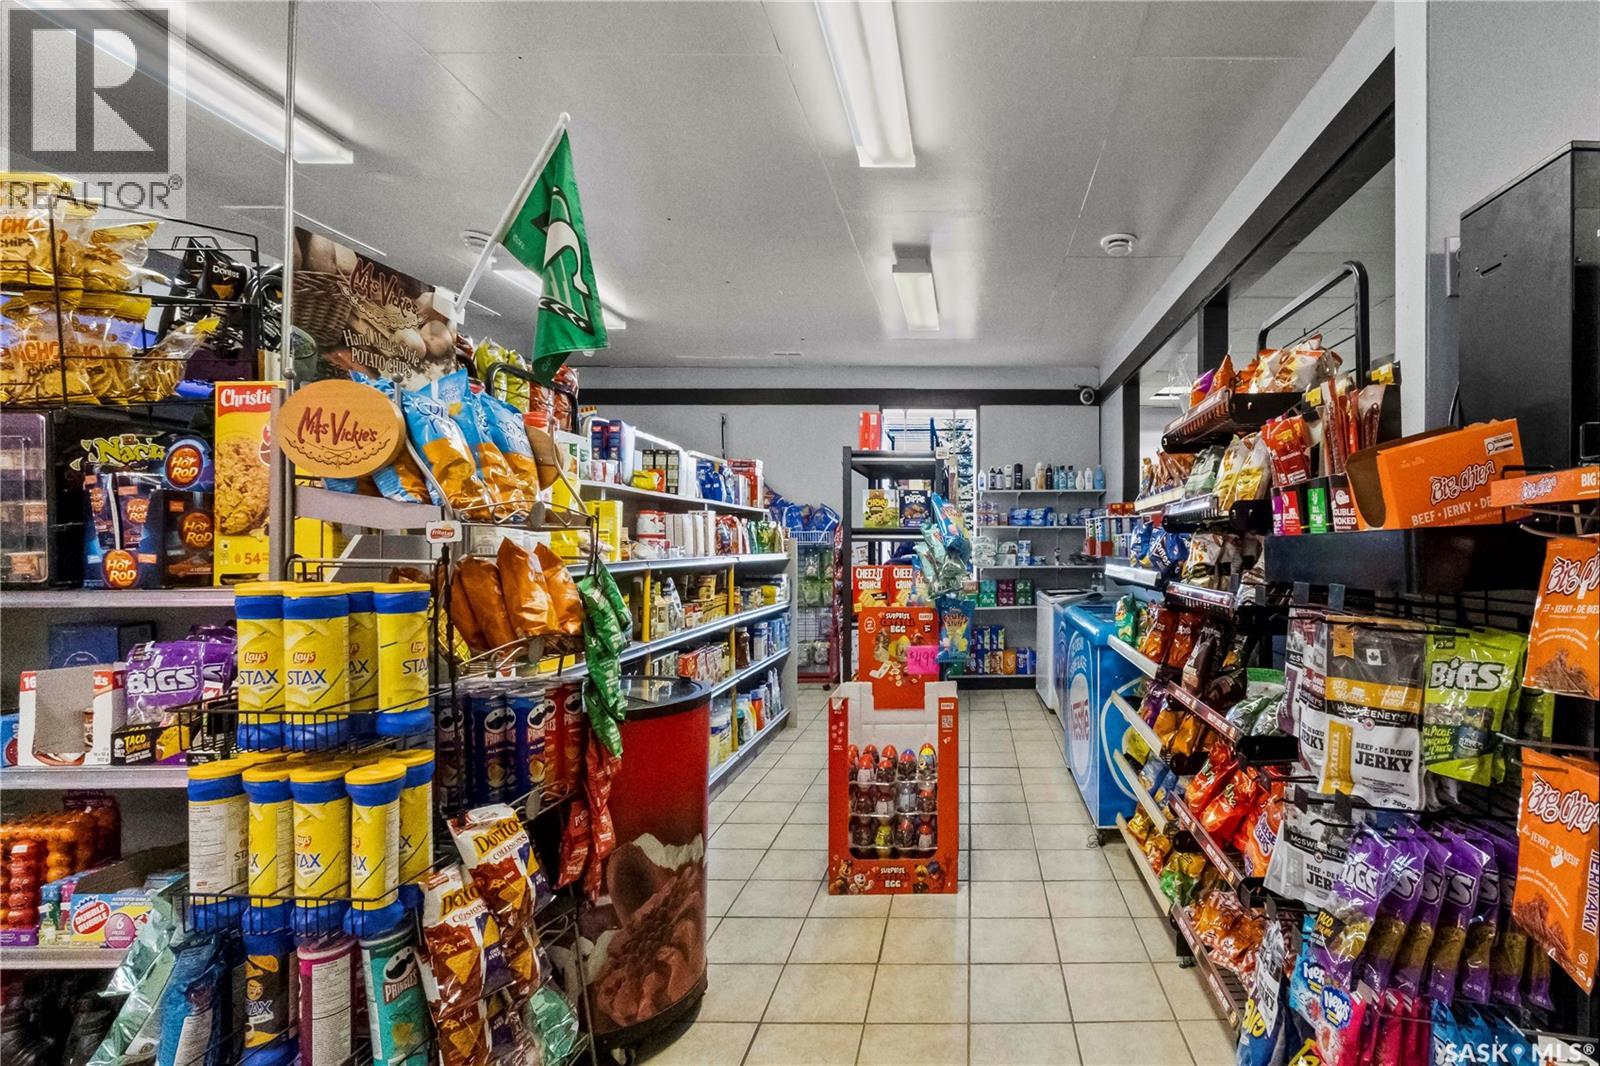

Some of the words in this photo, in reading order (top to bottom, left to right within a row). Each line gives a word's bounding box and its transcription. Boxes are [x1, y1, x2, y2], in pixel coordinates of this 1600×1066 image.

[378, 271, 418, 318] Vickie's
[343, 329, 372, 347] Hand
[399, 345, 420, 367] Style
[351, 347, 386, 370] POTATO
[330, 409, 378, 450] Vickie's
[1430, 476, 1461, 505] Big
[1459, 460, 1496, 492] Chief
[1411, 510, 1436, 526] BEEF
[1443, 501, 1472, 519] JERKY
[244, 552, 262, 566] 54
[893, 567, 913, 579] CHEEZ
[1546, 556, 1582, 596] Big
[890, 625, 906, 633] EGG
[350, 659, 370, 674] AX
[239, 669, 279, 686] STAX
[287, 669, 327, 686] STAX
[125, 735, 146, 749] TACO
[1356, 742, 1374, 752] BEEF
[1355, 750, 1413, 773] JERKY
[234, 850, 249, 862] STA
[352, 855, 367, 872] AX
[1306, 871, 1333, 891] JER
[116, 917, 125, 930] 6
[384, 971, 418, 1003] PRINGLES
